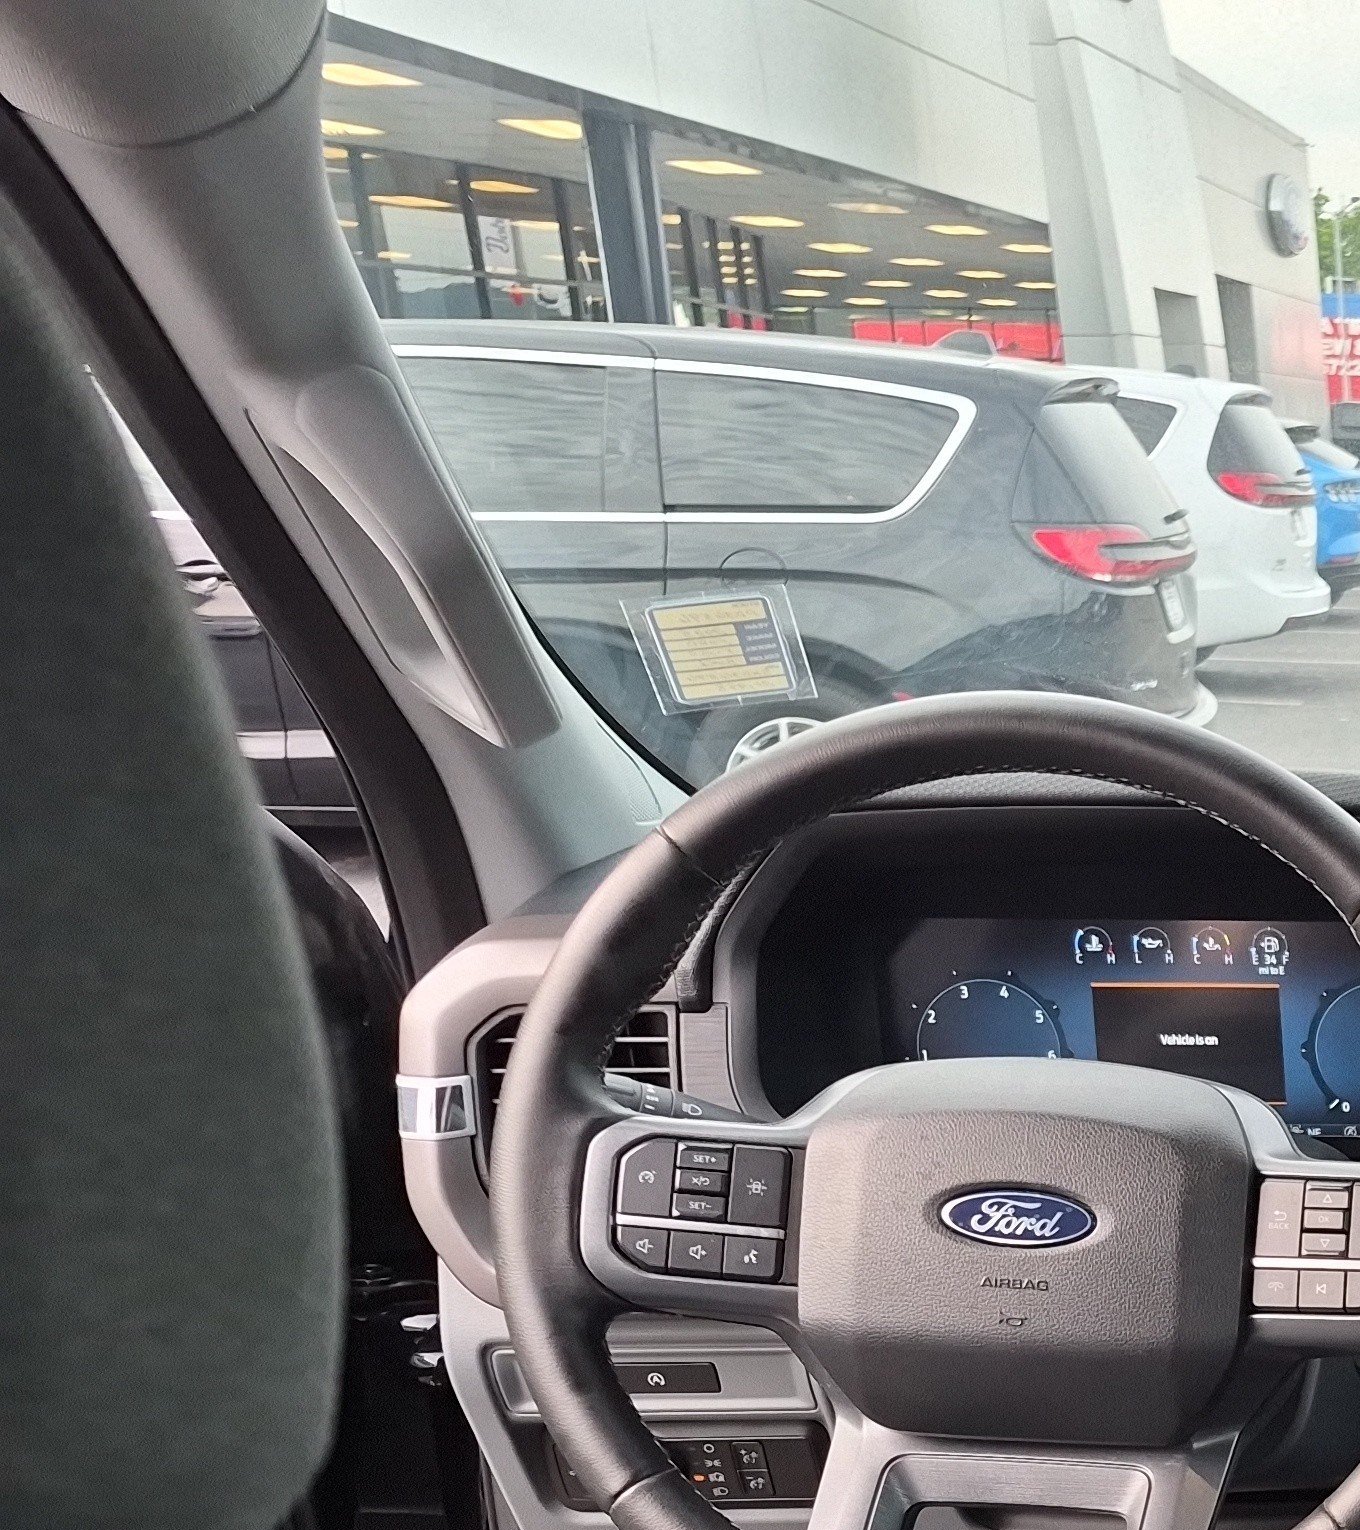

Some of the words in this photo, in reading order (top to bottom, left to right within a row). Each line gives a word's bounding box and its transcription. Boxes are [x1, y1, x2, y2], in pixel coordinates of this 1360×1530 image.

[1075, 953, 1084, 965] C
[1107, 953, 1116, 965] H
[1135, 953, 1142, 964] L
[1165, 953, 1174, 965] H
[1193, 954, 1201, 965] C
[1225, 954, 1233, 965] H
[1264, 954, 1277, 965] 34
[960, 985, 969, 999] 3
[1000, 985, 1010, 999] 4
[927, 1009, 937, 1024] 2
[1035, 1009, 1044, 1024] 5
[1160, 1034, 1196, 1046] Vehicle
[1341, 1101, 1351, 1113] 0
[970, 1197, 1064, 1237] Ford
[1268, 1222, 1290, 1230] BACK
[980, 1276, 1049, 1291] AIRBAG
